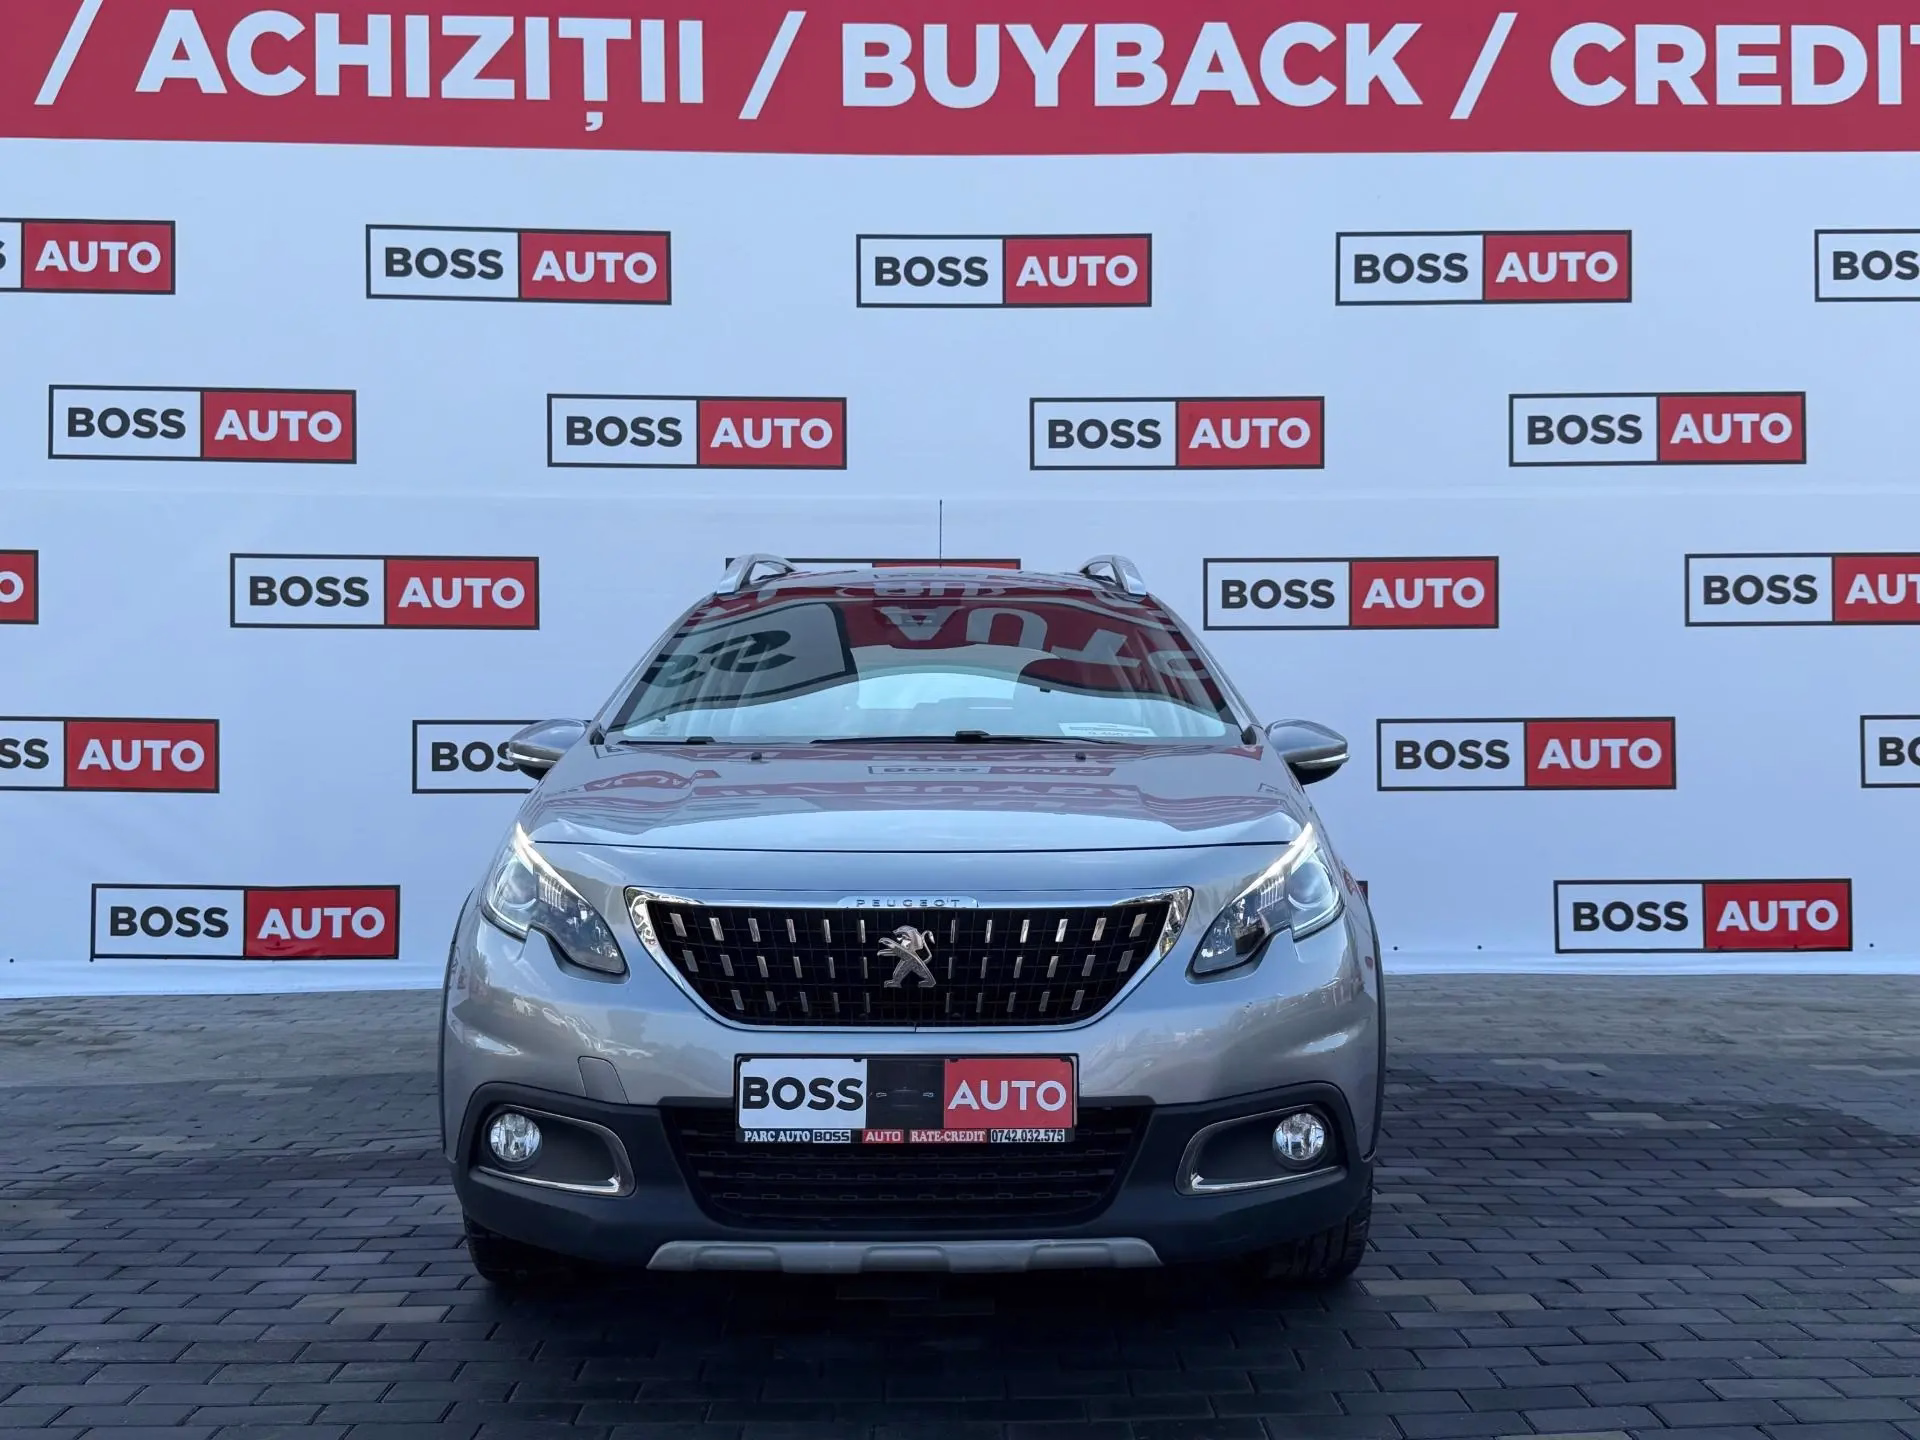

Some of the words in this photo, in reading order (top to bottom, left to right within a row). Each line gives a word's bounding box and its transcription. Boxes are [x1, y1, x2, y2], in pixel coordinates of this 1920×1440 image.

[136, 10, 703, 131] ACHIZIȚII
[843, 22, 1423, 108] BUYBACK
[36, 241, 160, 273] AUTO
[386, 247, 503, 280] BOSS
[533, 251, 656, 283] AUTO
[875, 257, 988, 287] BOSS
[1016, 256, 1137, 286] AUTO
[1355, 253, 1468, 284] BOSS
[1496, 252, 1617, 282] AUTO
[1833, 250, 1920, 280] BOS
[68, 408, 185, 439] BOSS
[215, 410, 341, 442] AUTO
[567, 416, 682, 447] BOSS
[711, 418, 832, 448] AUTO
[1048, 419, 1161, 449] BOSS
[1189, 418, 1310, 448] AUTO
[1528, 414, 1642, 445] BOSS
[1671, 413, 1792, 444] AUTO
[250, 576, 369, 607] BOSS
[399, 577, 524, 608] AUTO
[1222, 579, 1335, 609] BOSS
[1363, 578, 1484, 608] AUTO
[1704, 575, 1817, 605] BOSS
[78, 739, 204, 771] AUTO
[1396, 740, 1509, 769] BOSS
[1538, 738, 1661, 769] AUTO
[856, 899, 960, 907] PEUGEOT
[1573, 901, 1688, 931] BOSS
[1717, 900, 1838, 931] AUTO
[110, 906, 228, 938] BOSS
[258, 907, 384, 939] AUTO
[743, 1077, 863, 1111] BOSS
[948, 1080, 1066, 1111] AUTO
[744, 1130, 776, 1142] PARC
[778, 1130, 811, 1142] AUTO
[814, 1131, 850, 1142] BOSS
[865, 1131, 901, 1142] AUTO
[911, 1130, 985, 1142] RATE-CREDIT
[991, 1129, 1064, 1142] 0742.032.575
